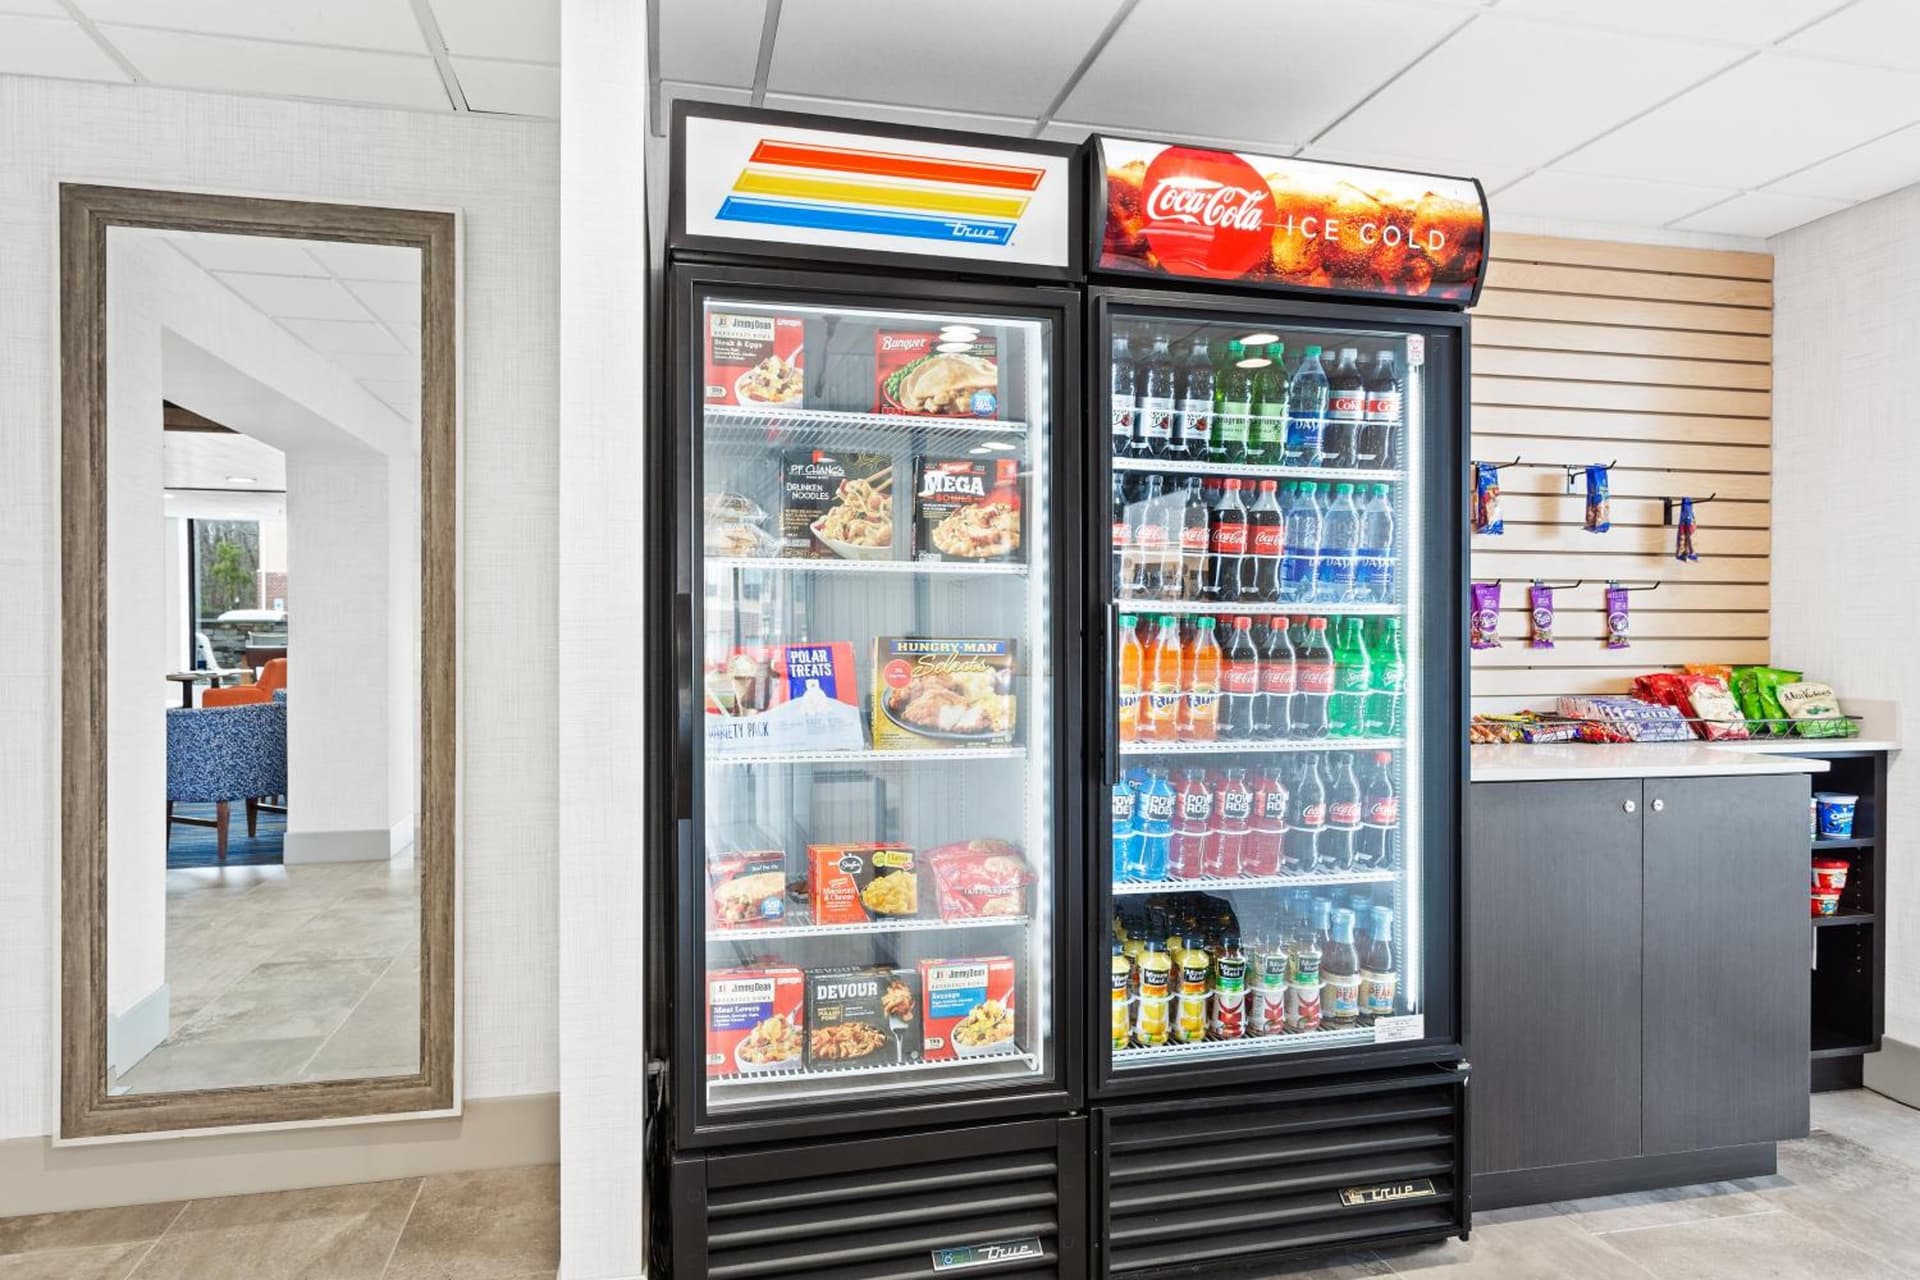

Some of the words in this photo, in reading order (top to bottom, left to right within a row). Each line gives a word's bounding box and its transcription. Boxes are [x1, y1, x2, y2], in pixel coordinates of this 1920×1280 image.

[1147, 177, 1269, 231] Coca-Cola
[1286, 215, 1340, 241] ICE
[1360, 223, 1446, 251] COLD
[881, 335, 926, 351] Banquet
[786, 482, 823, 492] DRUNKEN
[918, 471, 986, 497] MEGA
[792, 491, 830, 501] NOODLES
[897, 641, 998, 653] HUNGRY-MAN
[790, 650, 828, 664] POLAR
[790, 663, 832, 677] TREATS
[747, 721, 769, 738] PACK
[816, 982, 878, 1000] DEVOUR
[978, 1245, 1033, 1260] True
